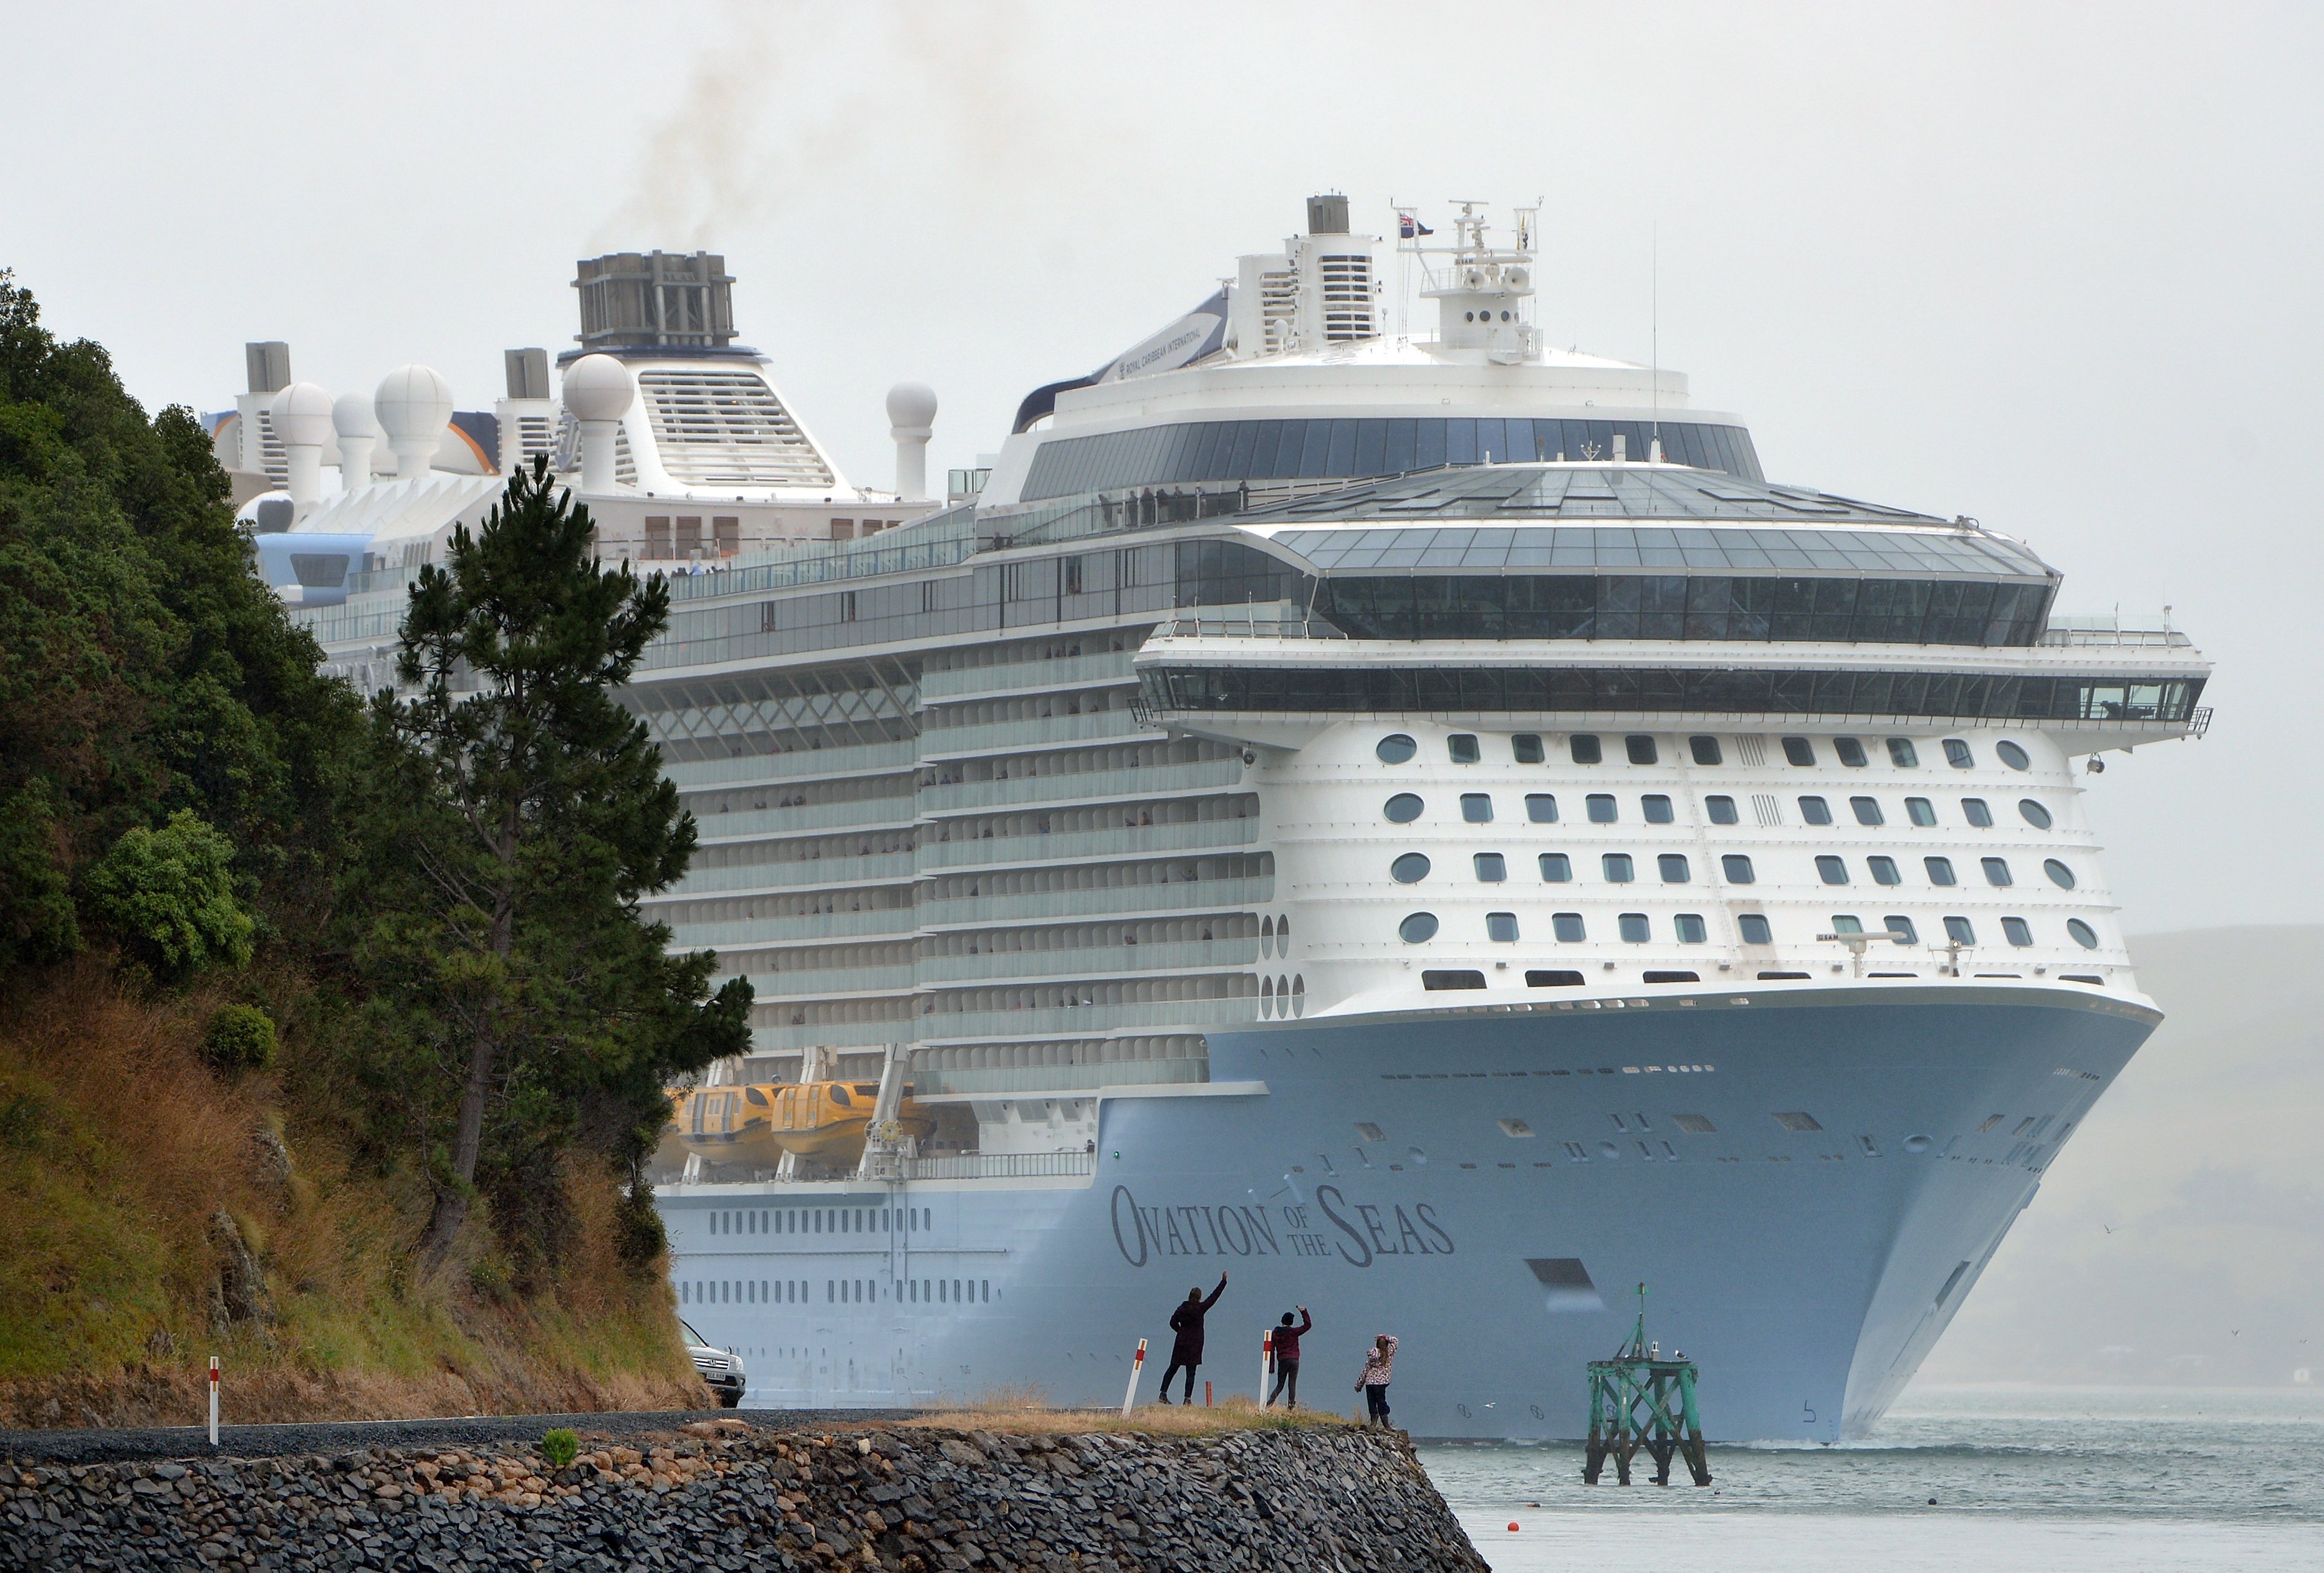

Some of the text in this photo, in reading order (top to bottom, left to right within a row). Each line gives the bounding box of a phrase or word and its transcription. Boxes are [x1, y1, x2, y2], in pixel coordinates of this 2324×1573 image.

[1126, 328, 1201, 374] ROYAL CARIBBEAN INTERNATIONAL
[1111, 1185, 1455, 1268] OVATION OF THE SEAS
